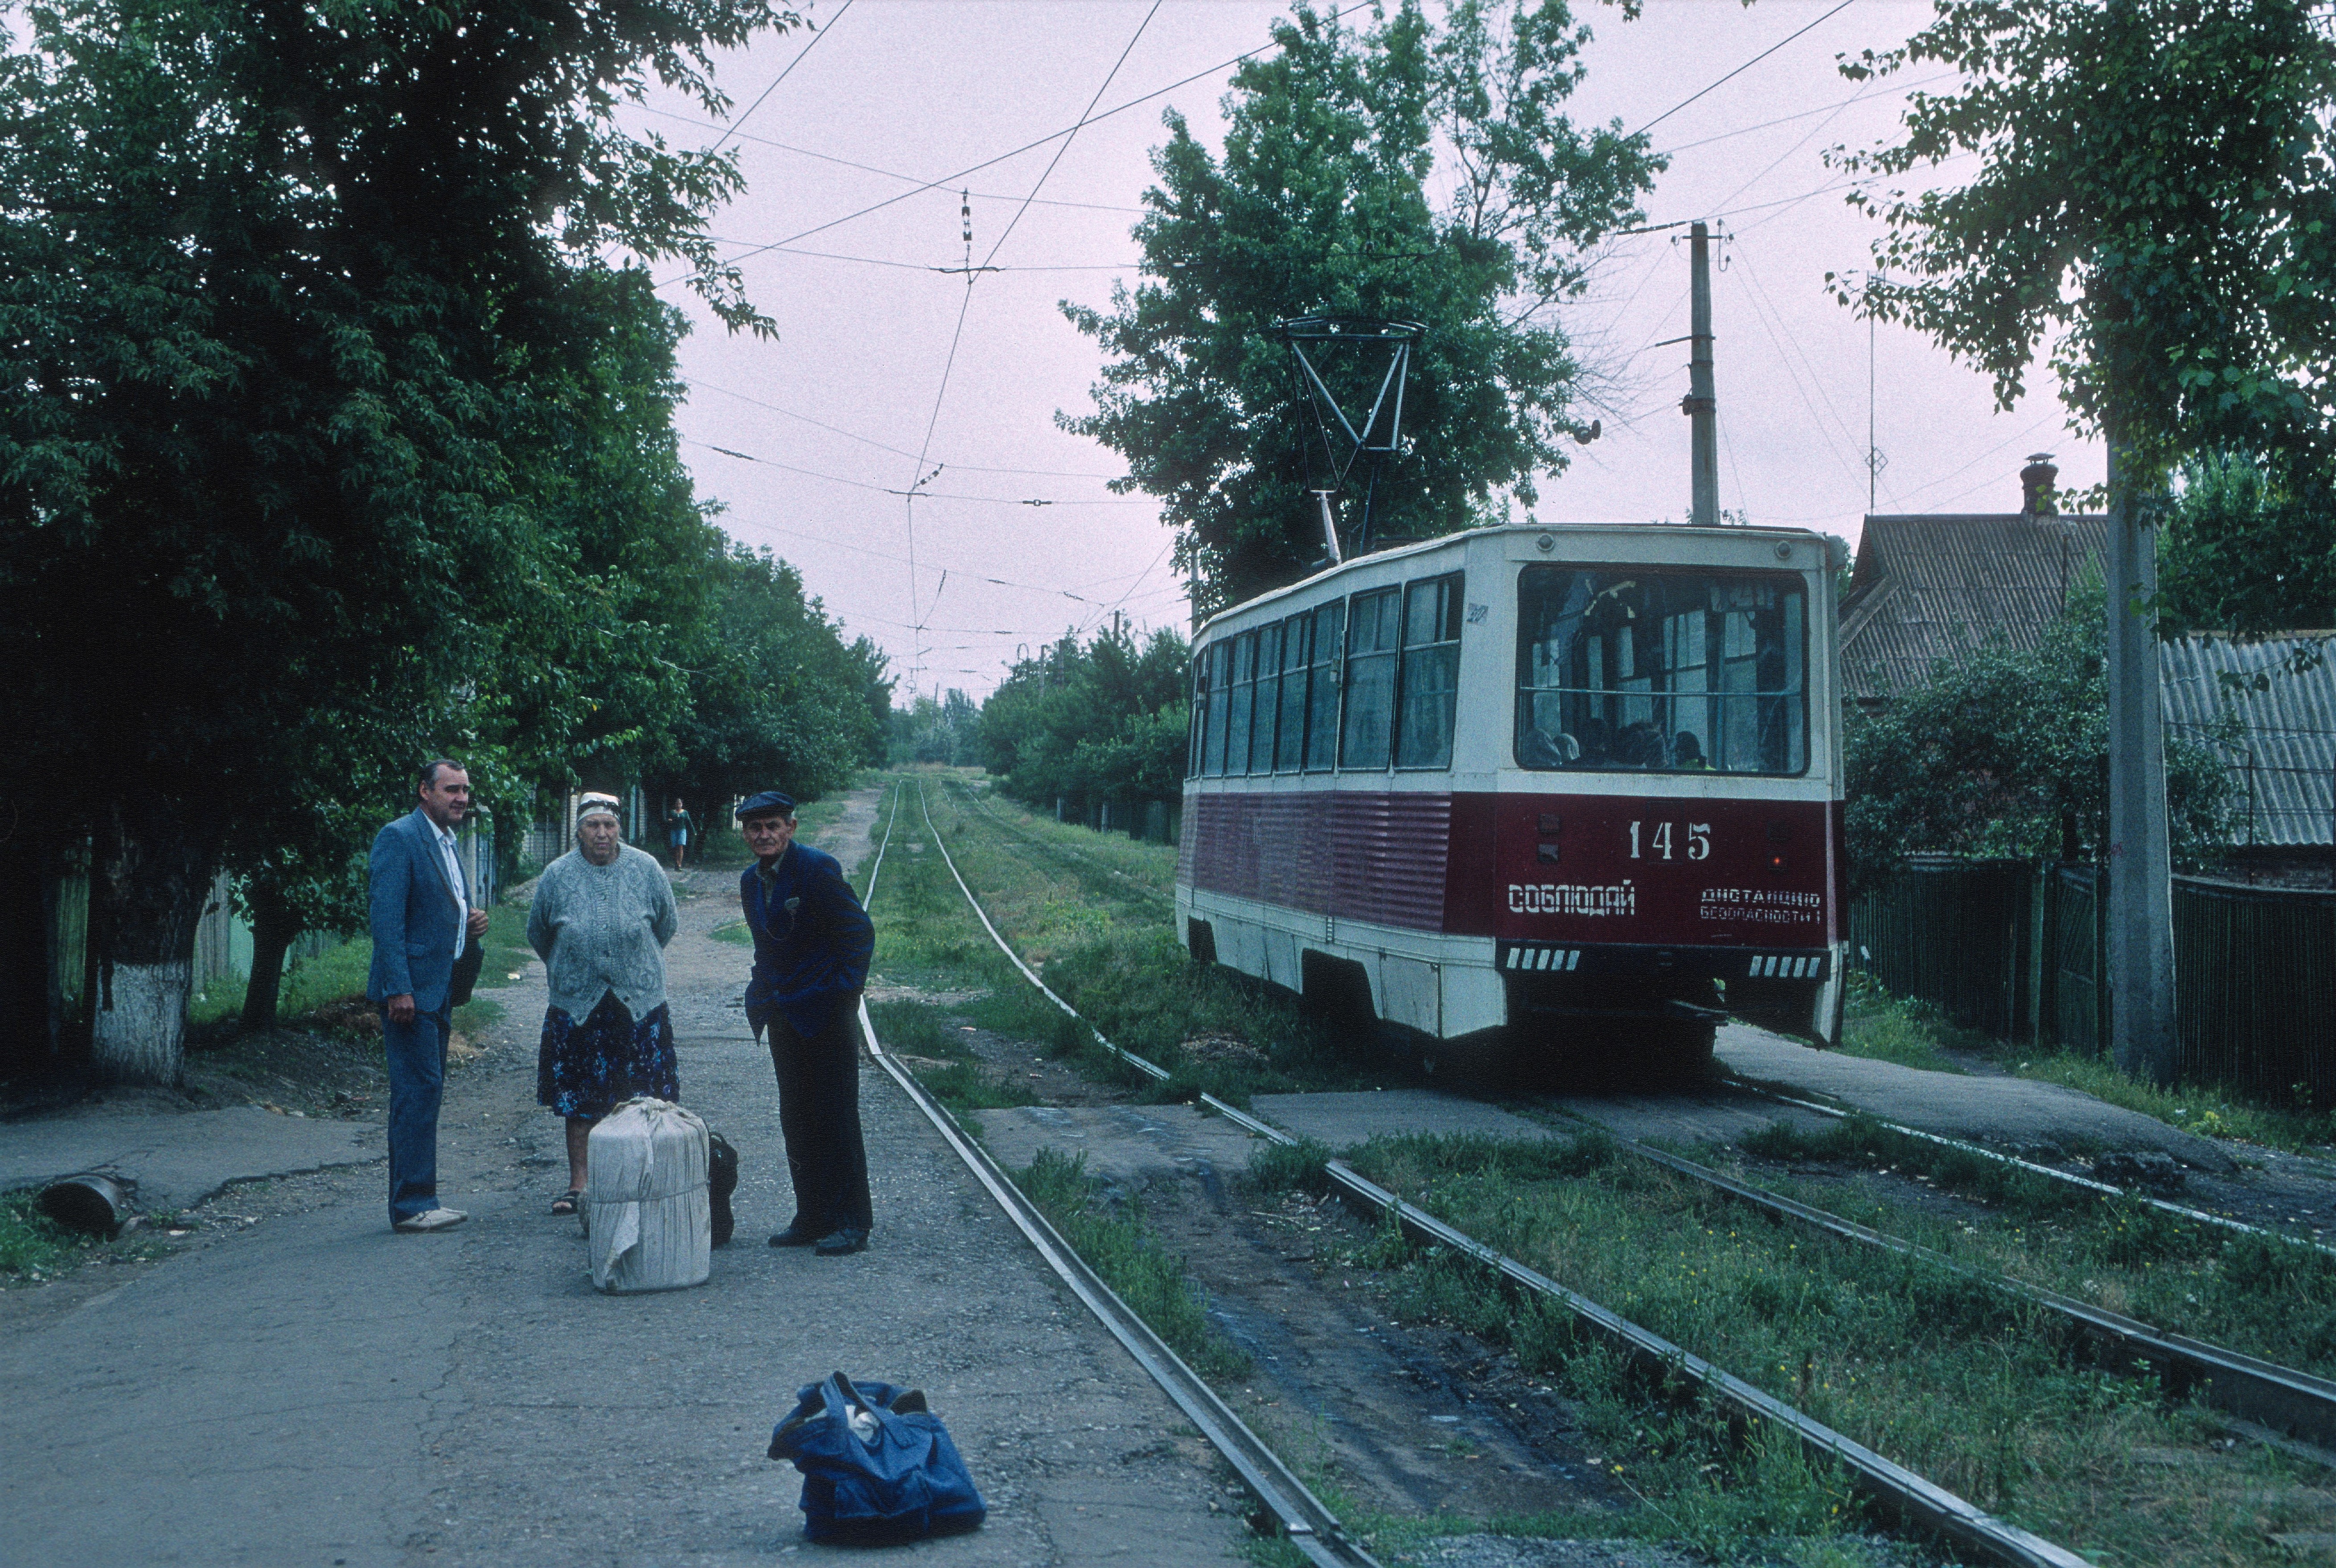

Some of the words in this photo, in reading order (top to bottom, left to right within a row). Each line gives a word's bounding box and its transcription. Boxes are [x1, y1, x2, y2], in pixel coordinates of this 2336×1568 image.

[1630, 821, 1711, 860] 145
[1509, 879, 1635, 917] СОБЛЮДАЙ
[1701, 889, 1820, 907] ДИСТАНЦИЮ
